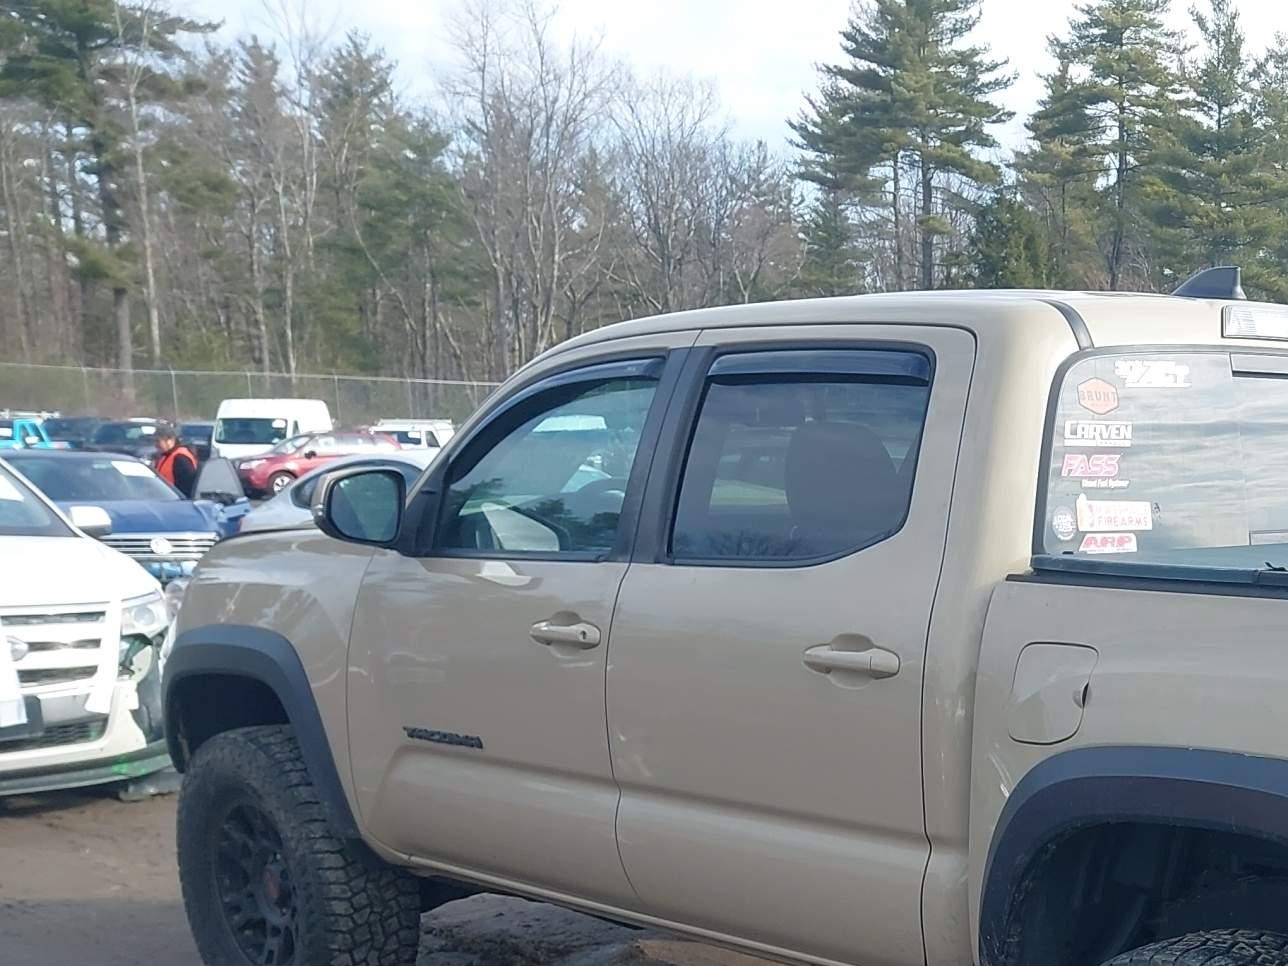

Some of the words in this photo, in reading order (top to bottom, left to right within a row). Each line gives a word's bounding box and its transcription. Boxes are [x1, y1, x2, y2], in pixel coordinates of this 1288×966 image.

[1064, 421, 1132, 441] CARVEN
[1061, 454, 1121, 477] FASS
[1096, 516, 1148, 528] FIREARMS
